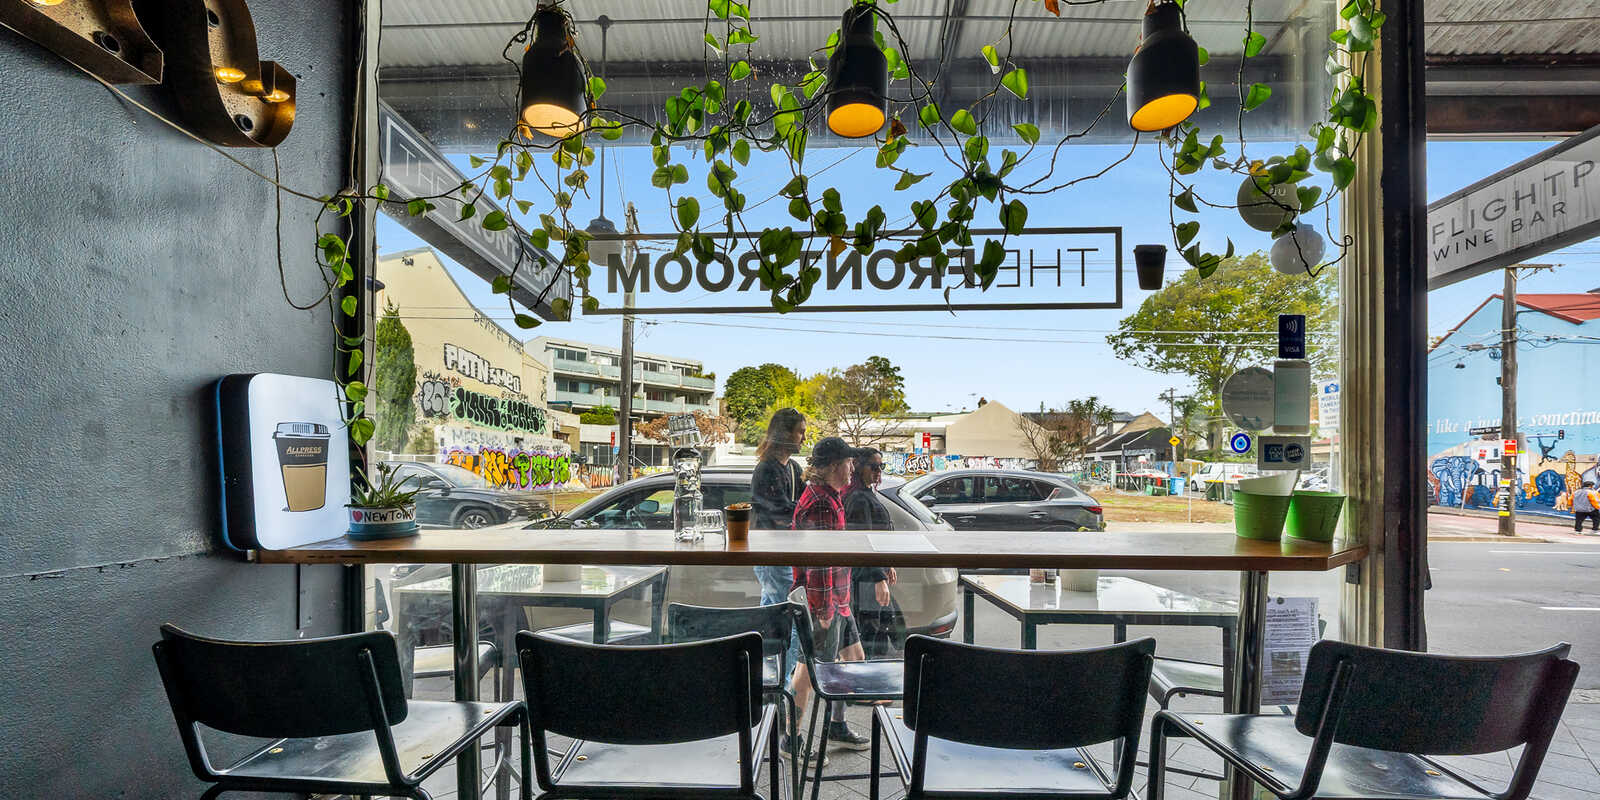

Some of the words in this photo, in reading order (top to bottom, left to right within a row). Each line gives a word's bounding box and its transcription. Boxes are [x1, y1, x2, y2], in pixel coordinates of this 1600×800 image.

[1432, 160, 1595, 245] FLIGHTP
[1434, 229, 1494, 262] WINE
[1511, 201, 1567, 234] BAR
[1436, 418, 1458, 434] like
[286, 446, 322, 455] ALLPRESS
